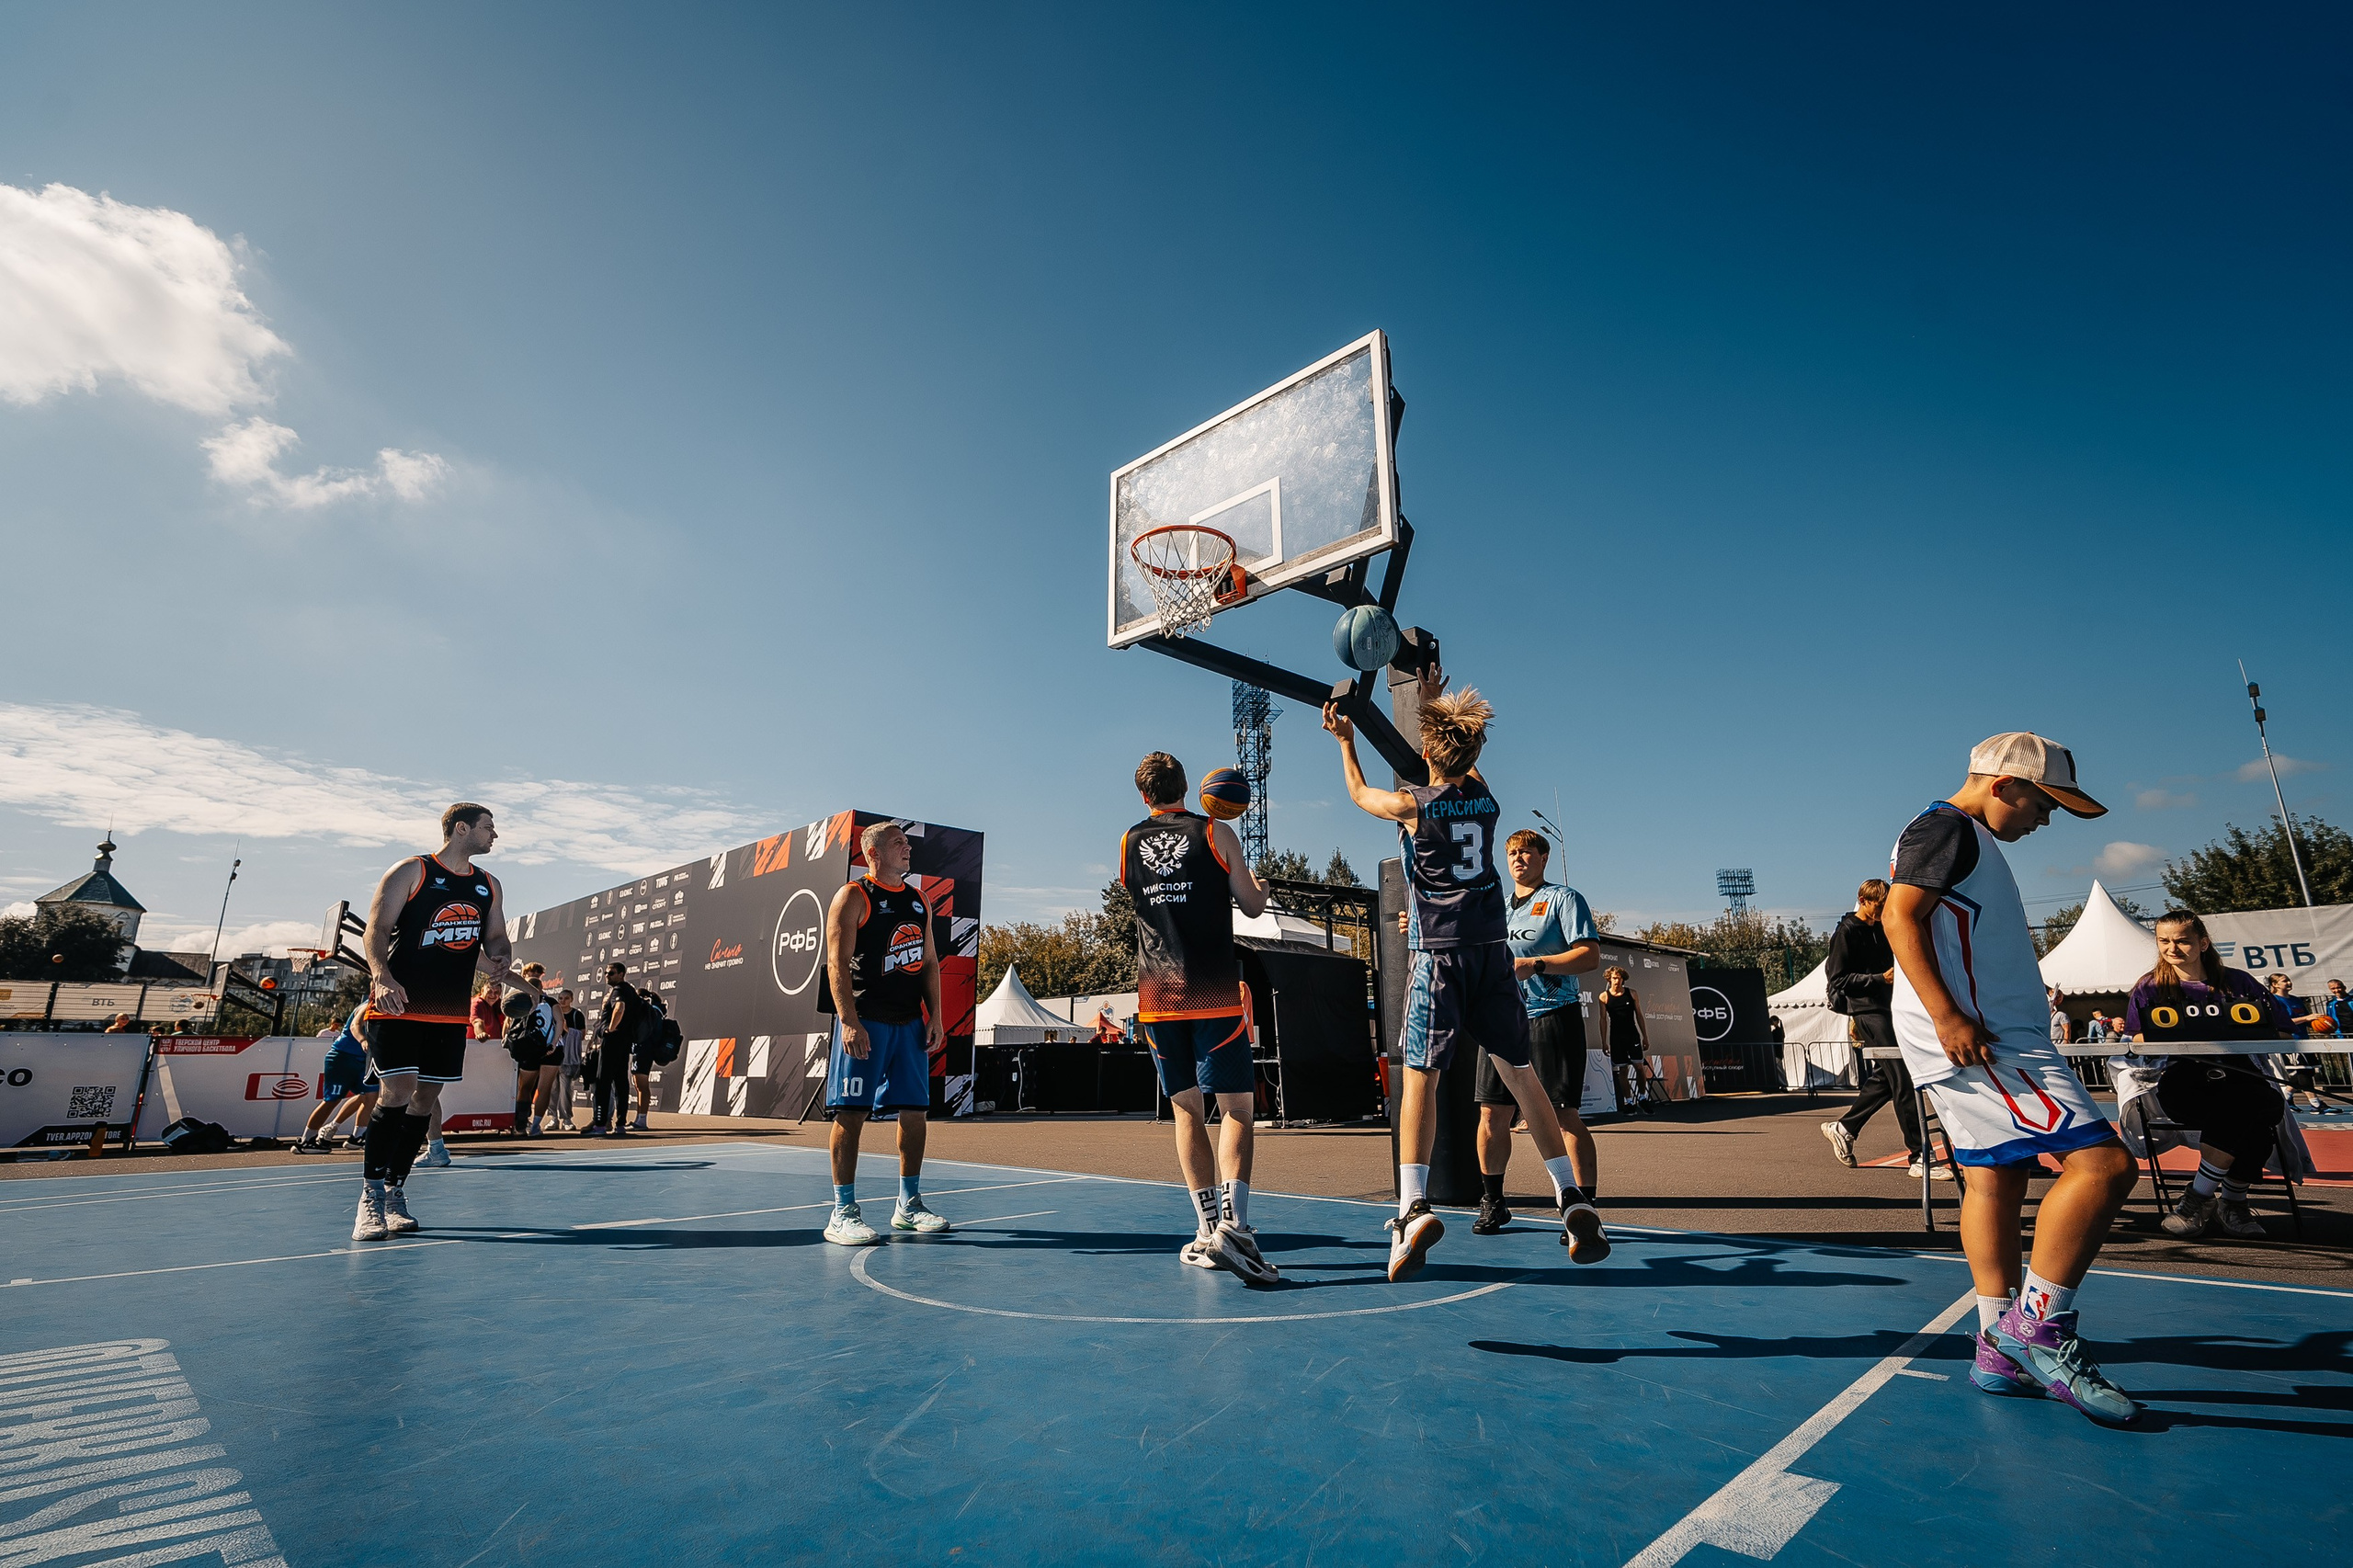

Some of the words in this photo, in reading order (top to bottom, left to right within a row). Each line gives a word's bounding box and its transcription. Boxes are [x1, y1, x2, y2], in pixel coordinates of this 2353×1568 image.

[1425, 797, 1495, 819] ГЕРАСИМОВ
[1450, 821, 1483, 881] 3
[1142, 882, 1193, 895] МИНСПОРТ
[1150, 894, 1187, 906] РОССИИ
[422, 926, 481, 947] МЯЧ
[779, 926, 817, 956] РФБ
[890, 938, 923, 952] ОРАНЖЕВЫ
[1508, 929, 1536, 941] KC
[884, 946, 924, 972] МЯ
[2243, 942, 2316, 969] ВТБ
[92, 998, 115, 1006] ВТБ
[2151, 1006, 2179, 1028] 0
[2186, 1005, 2200, 1017] 0
[2206, 1005, 2220, 1017] 0
[2230, 1003, 2260, 1025] 0
[331, 1085, 342, 1095] 11
[842, 1077, 863, 1096] 10
